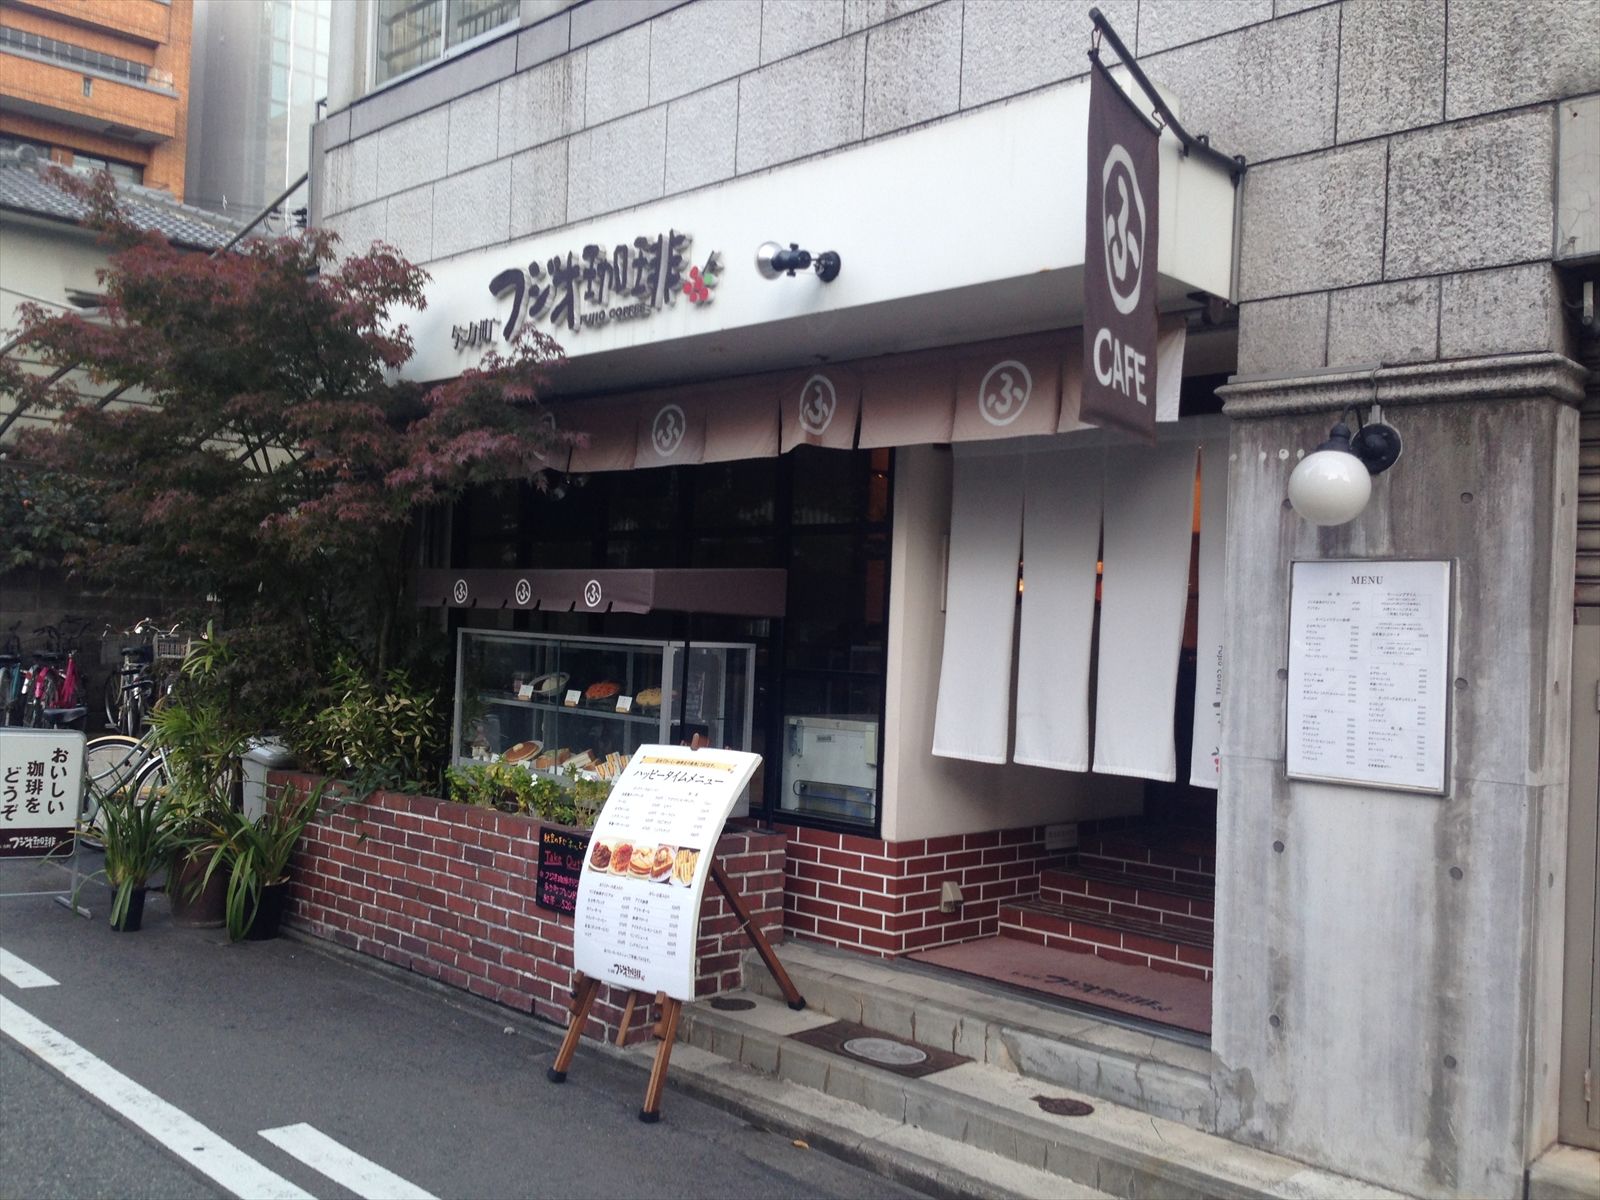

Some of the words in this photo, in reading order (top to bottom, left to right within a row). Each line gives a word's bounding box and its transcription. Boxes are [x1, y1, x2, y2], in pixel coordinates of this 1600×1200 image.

[489, 229, 691, 341] フジオ珈琲
[580, 310, 606, 325] FUJIO
[609, 303, 650, 320] COFFEE
[1093, 327, 1147, 407] CAFE
[1351, 576, 1384, 585] MENU
[1, 767, 21, 821] どうぞ
[25, 761, 45, 814] 珈琲を
[48, 748, 69, 815] おいしい
[633, 769, 724, 786] ハッピータイムメニュー
[9, 836, 57, 849] フジオ珈琲
